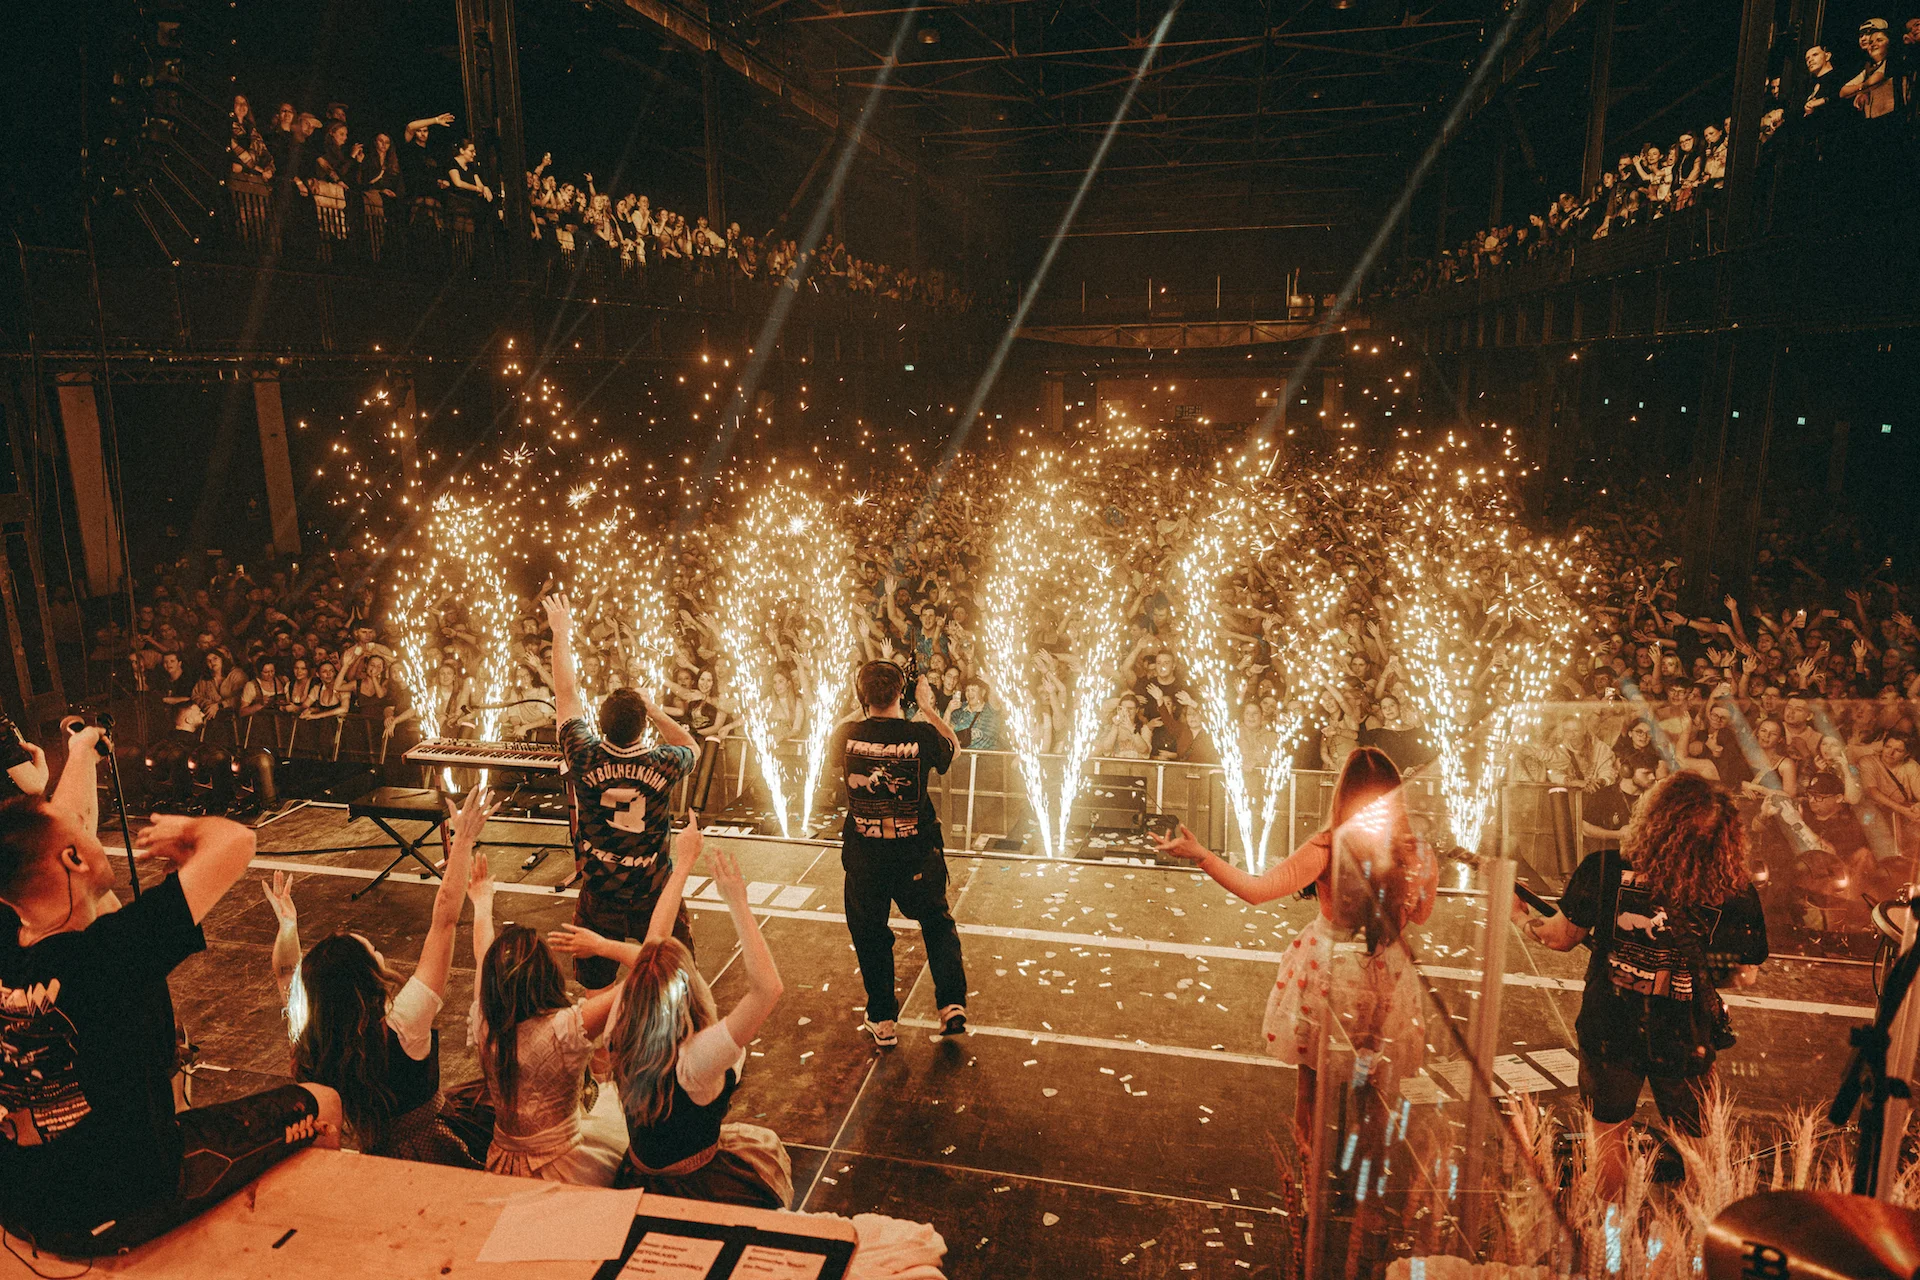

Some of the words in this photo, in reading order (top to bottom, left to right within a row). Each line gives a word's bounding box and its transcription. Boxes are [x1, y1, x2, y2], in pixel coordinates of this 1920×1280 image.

[846, 739, 920, 758] TREAM
[582, 774, 599, 788] SV
[598, 763, 668, 792] BÜCHELKÜHN
[600, 788, 647, 834] 3
[1609, 959, 1656, 980] TOUR
[1611, 970, 1653, 995] 24
